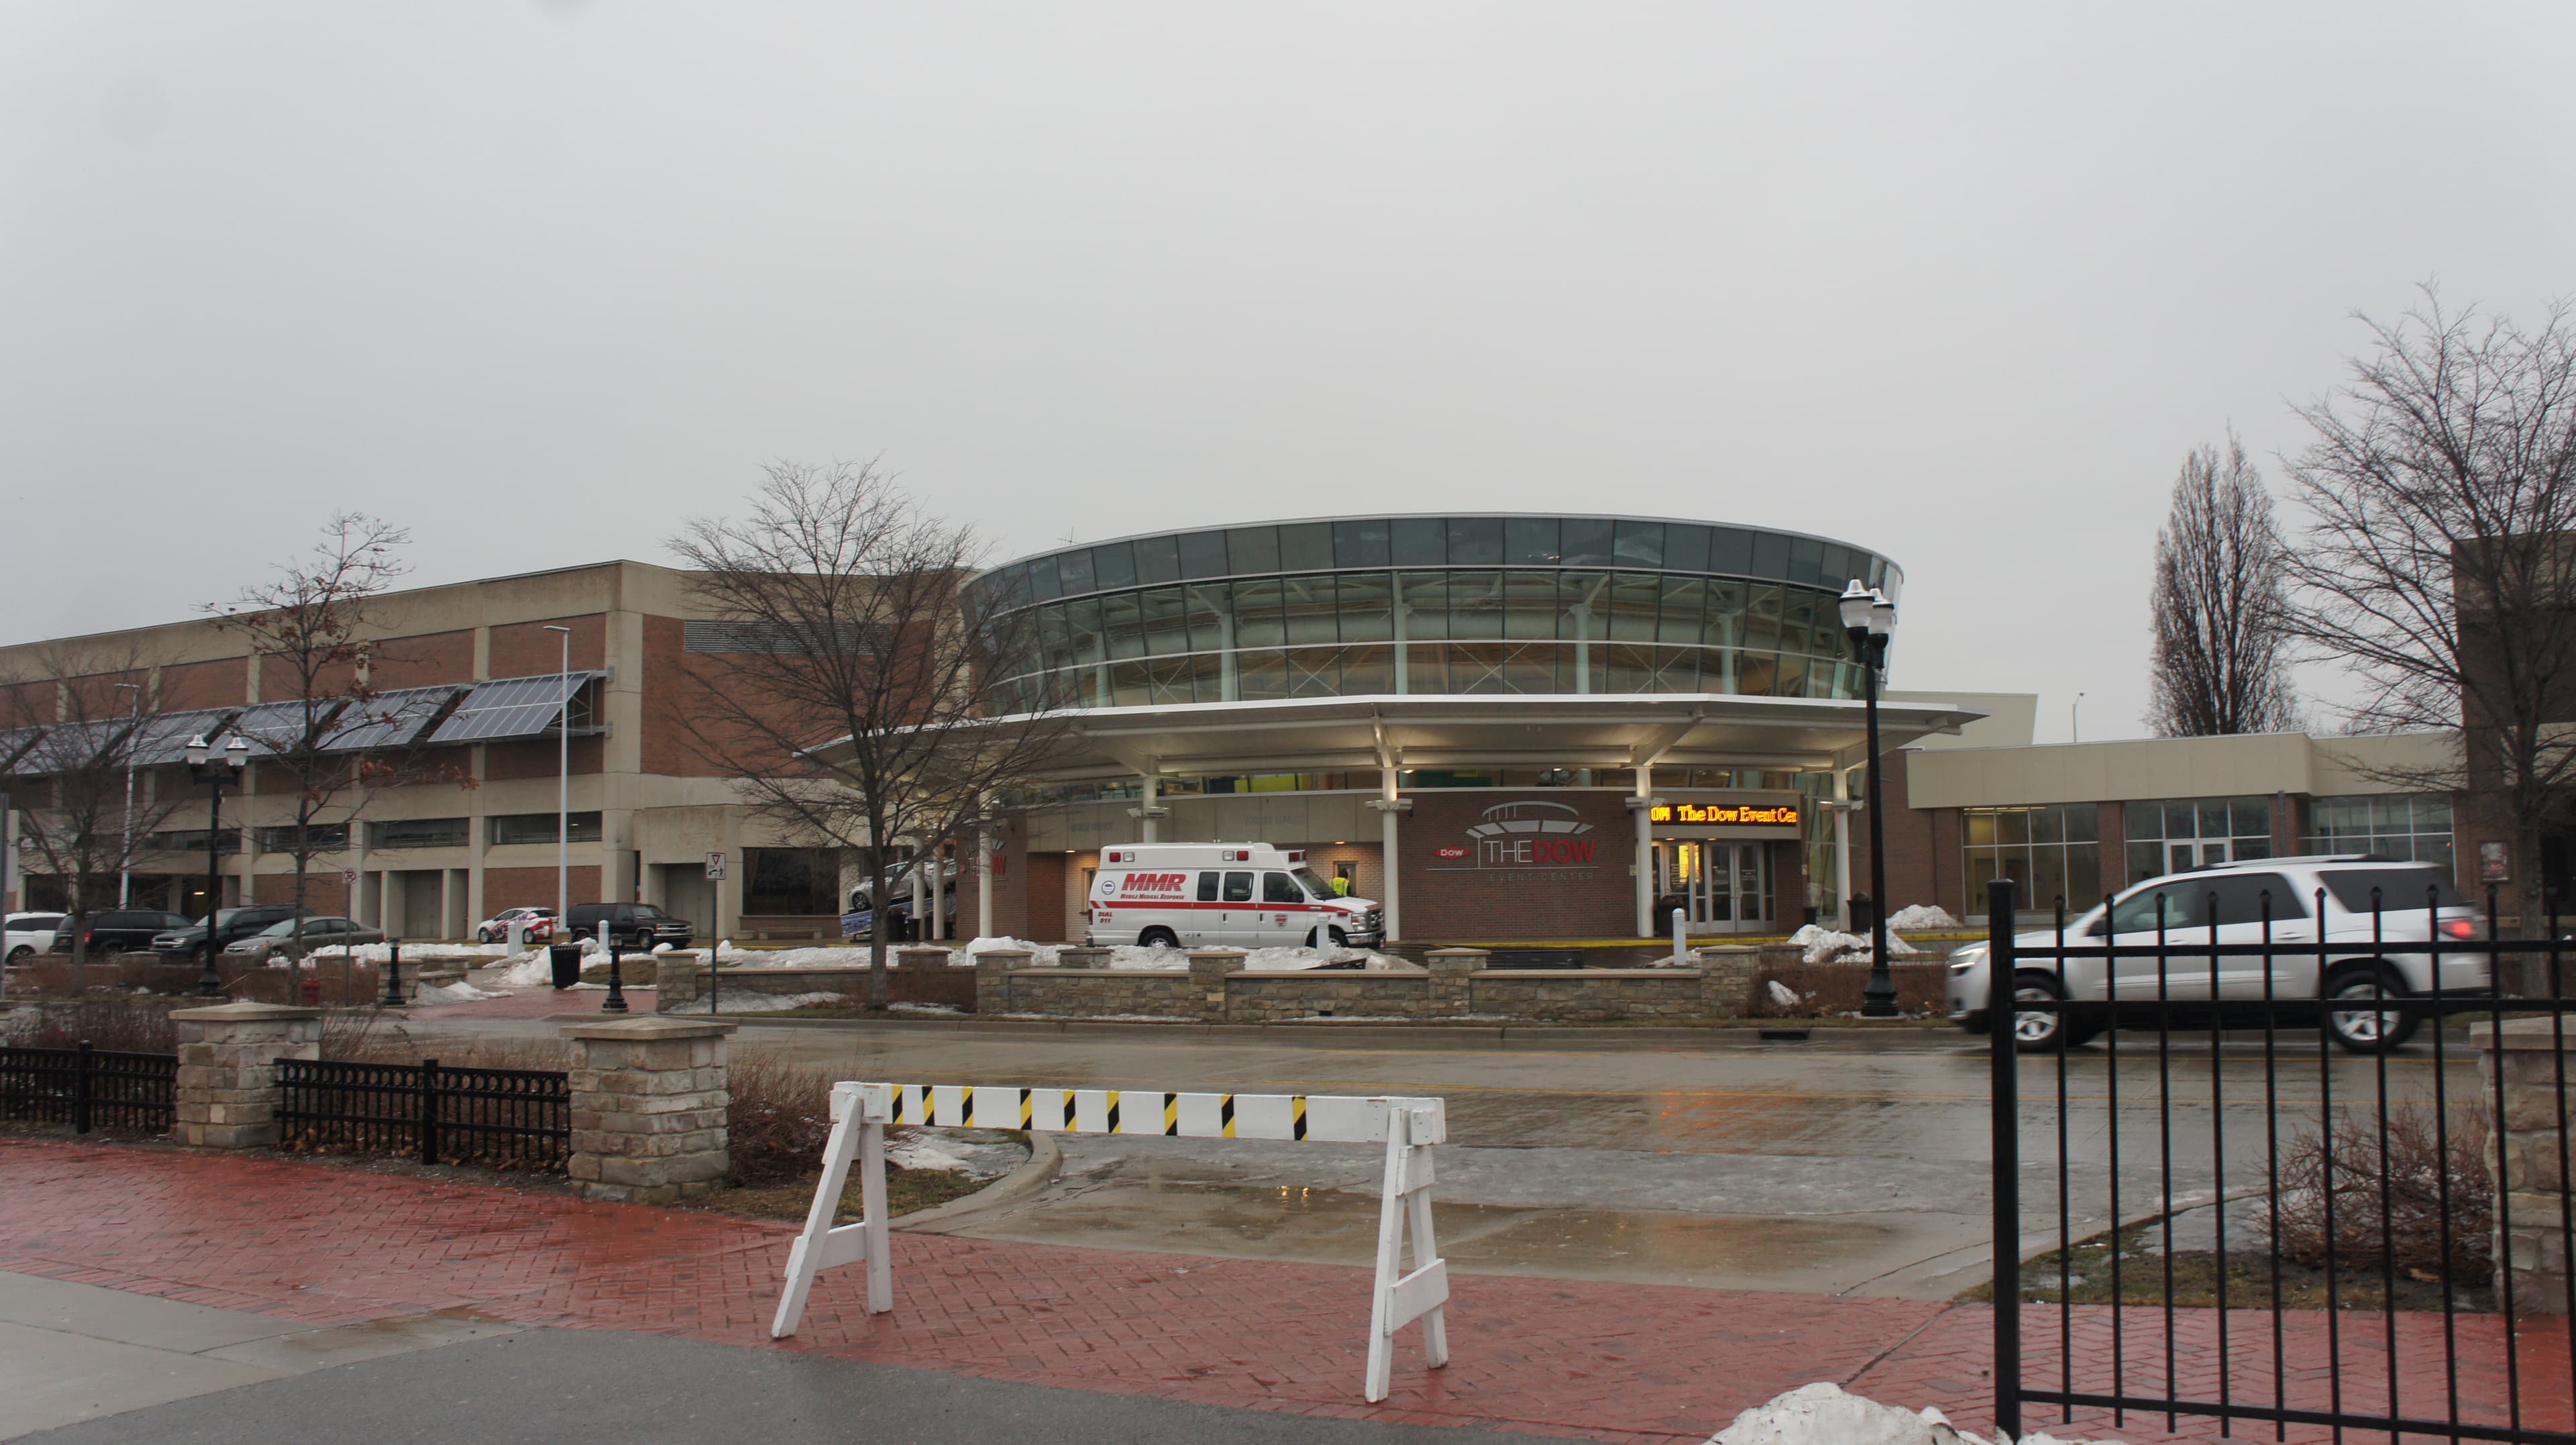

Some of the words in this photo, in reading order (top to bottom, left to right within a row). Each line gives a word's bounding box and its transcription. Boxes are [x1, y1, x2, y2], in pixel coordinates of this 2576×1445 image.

[1677, 804, 1707, 822] The
[1707, 806, 1738, 822] Dow
[1739, 806, 1777, 822] Event
[1440, 849, 1464, 857] Dow
[1483, 841, 1533, 863] THE
[1534, 840, 1597, 863] DOW
[1121, 873, 1187, 892] MMR
